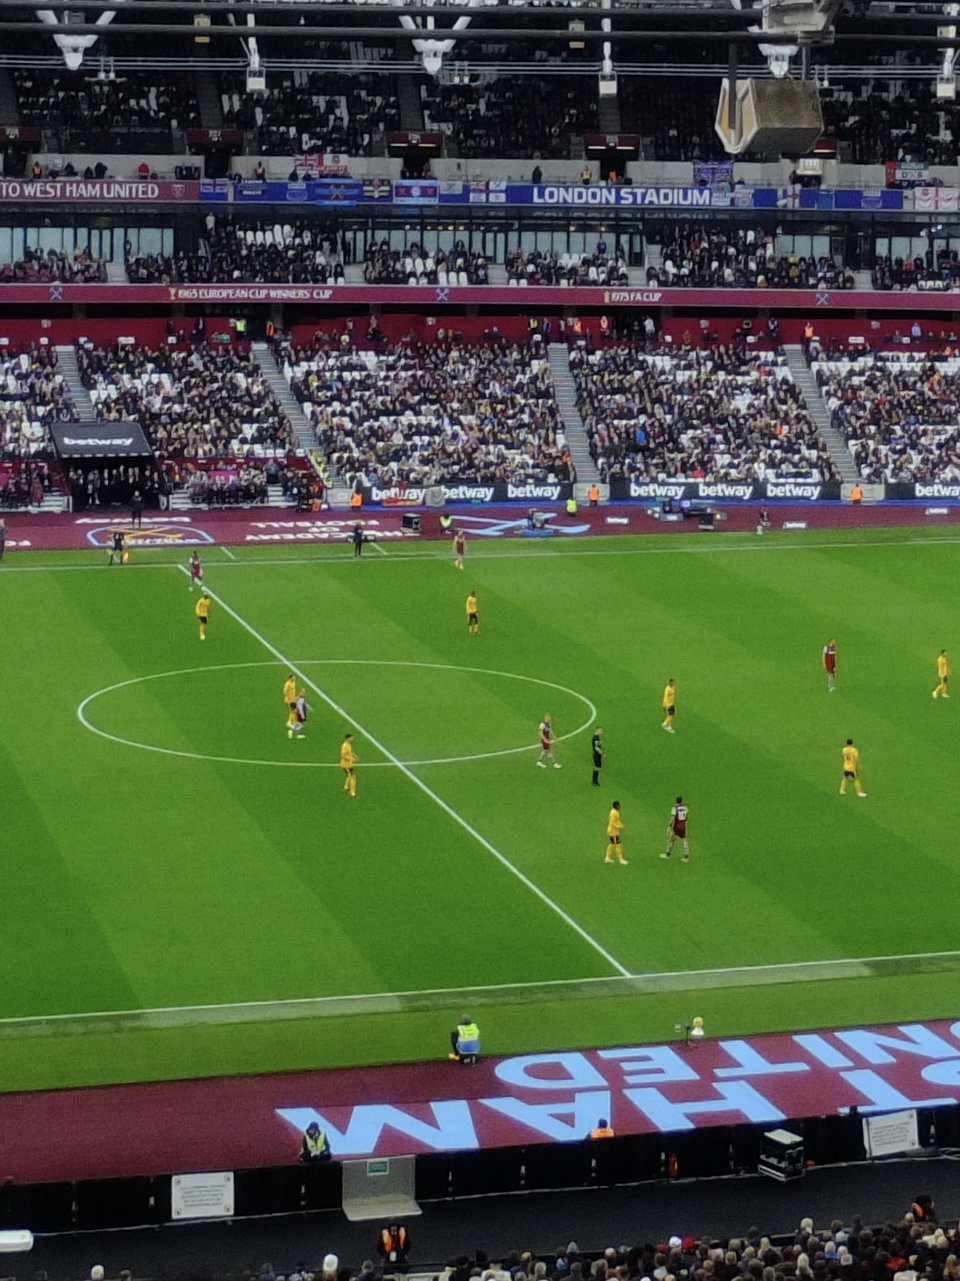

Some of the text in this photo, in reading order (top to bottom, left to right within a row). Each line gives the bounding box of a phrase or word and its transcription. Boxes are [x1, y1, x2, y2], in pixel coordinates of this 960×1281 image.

[0, 182, 159, 199] TO WEST HAM UNITED
[533, 187, 616, 204] LONDON
[620, 188, 710, 205] STADIUM
[200, 289, 248, 299] EUROPEAN
[249, 289, 268, 299] CUP
[313, 289, 333, 299] CUP
[630, 292, 642, 301] FA
[643, 292, 662, 302] CUP
[63, 436, 134, 446] betway
[441, 484, 494, 501] betway
[507, 483, 562, 500] betway
[630, 482, 685, 500] betway
[698, 483, 753, 500] betway
[766, 483, 821, 500] betway
[275, 1080, 786, 1155] HAM
